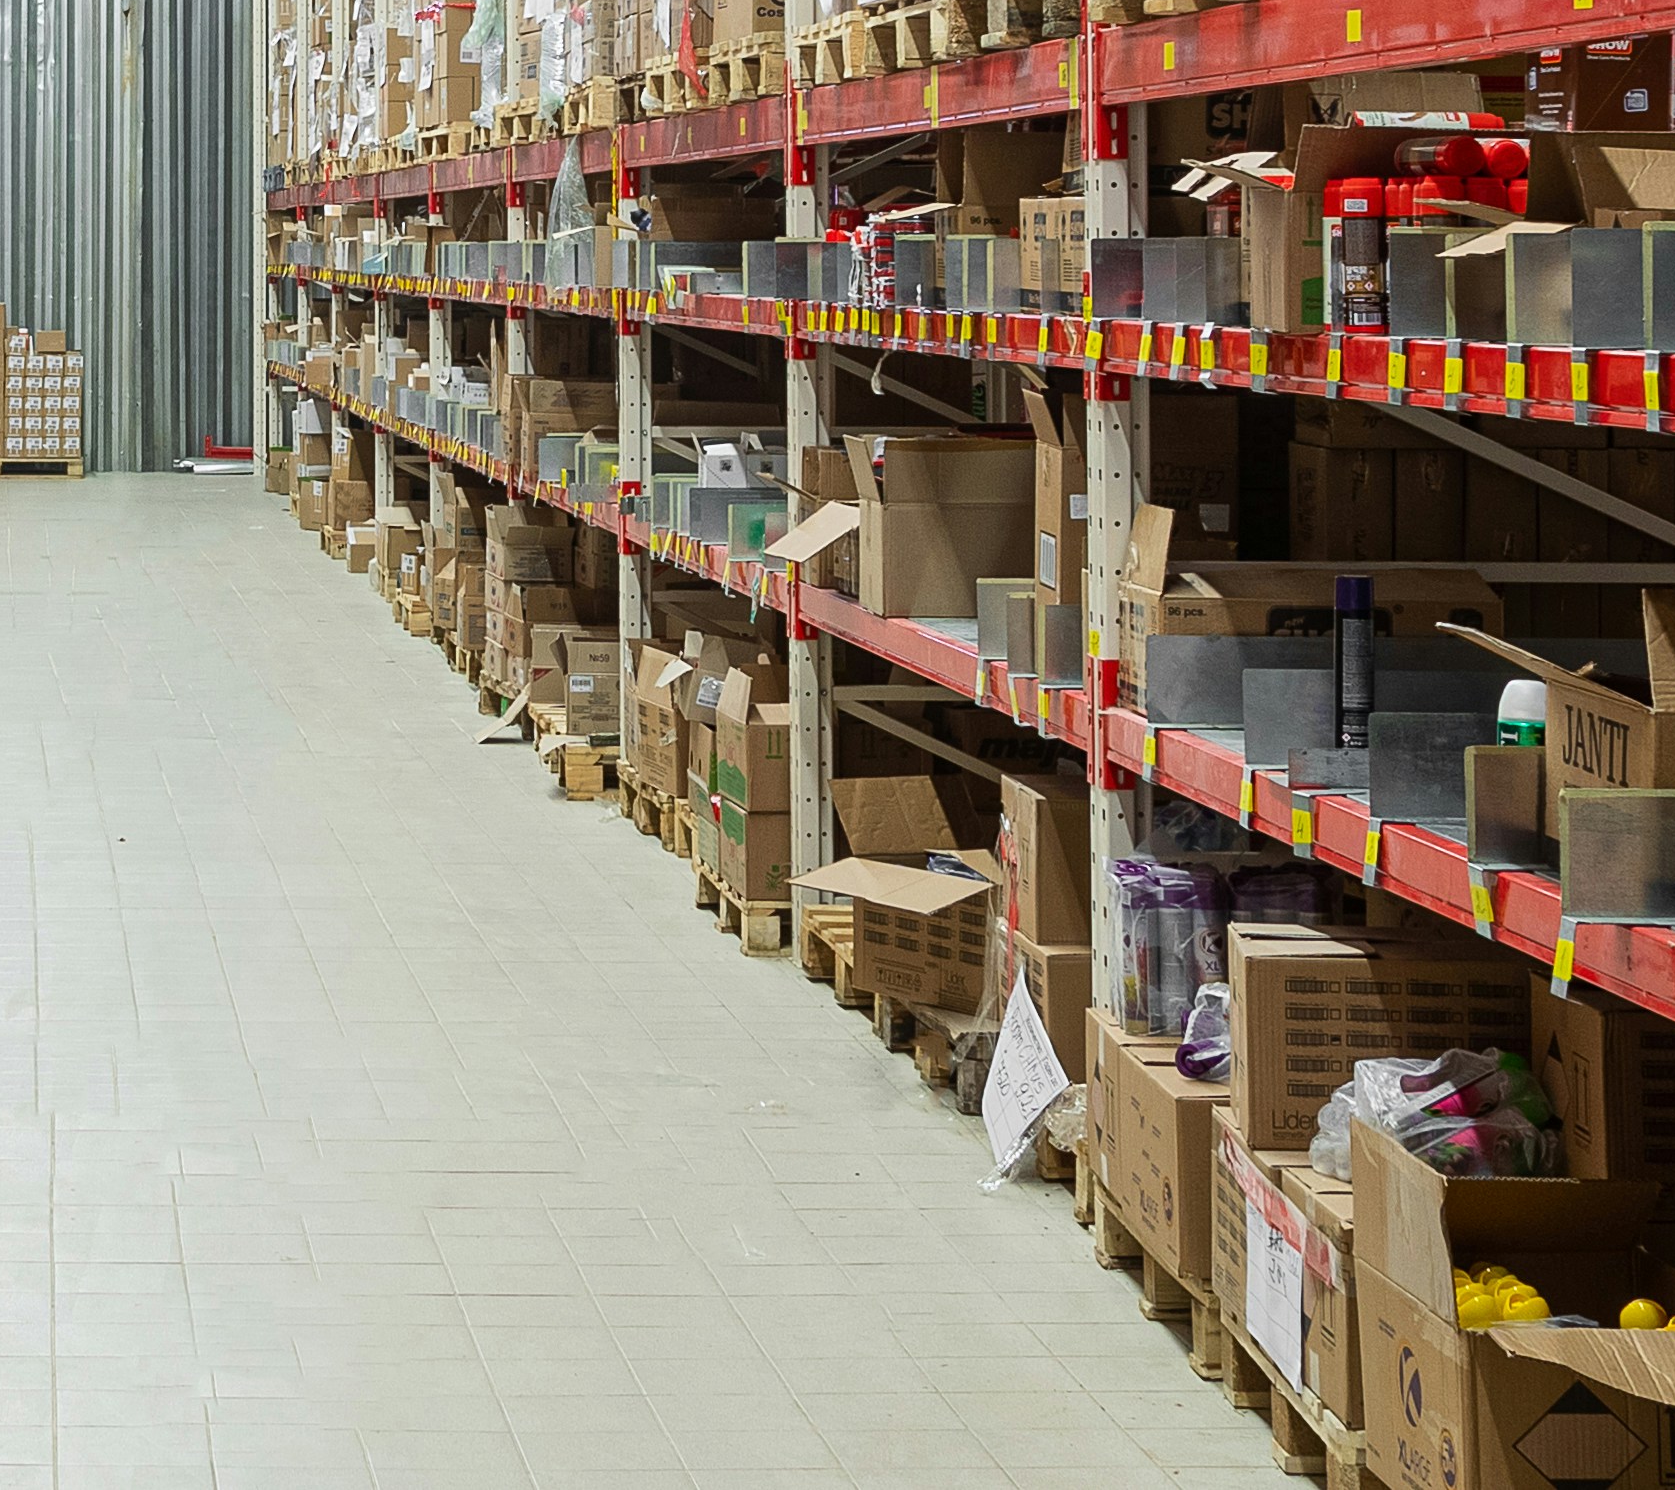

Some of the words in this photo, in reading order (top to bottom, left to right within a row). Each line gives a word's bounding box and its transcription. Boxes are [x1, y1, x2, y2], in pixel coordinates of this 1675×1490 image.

[755, 6, 786, 19] Cos
[1210, 100, 1251, 129] SH
[1167, 606, 1180, 616] 96
[1183, 607, 1207, 618] pcs.
[1561, 703, 1628, 788] JANTI
[1204, 960, 1221, 972] XL
[1395, 1435, 1431, 1484] XLARGE
